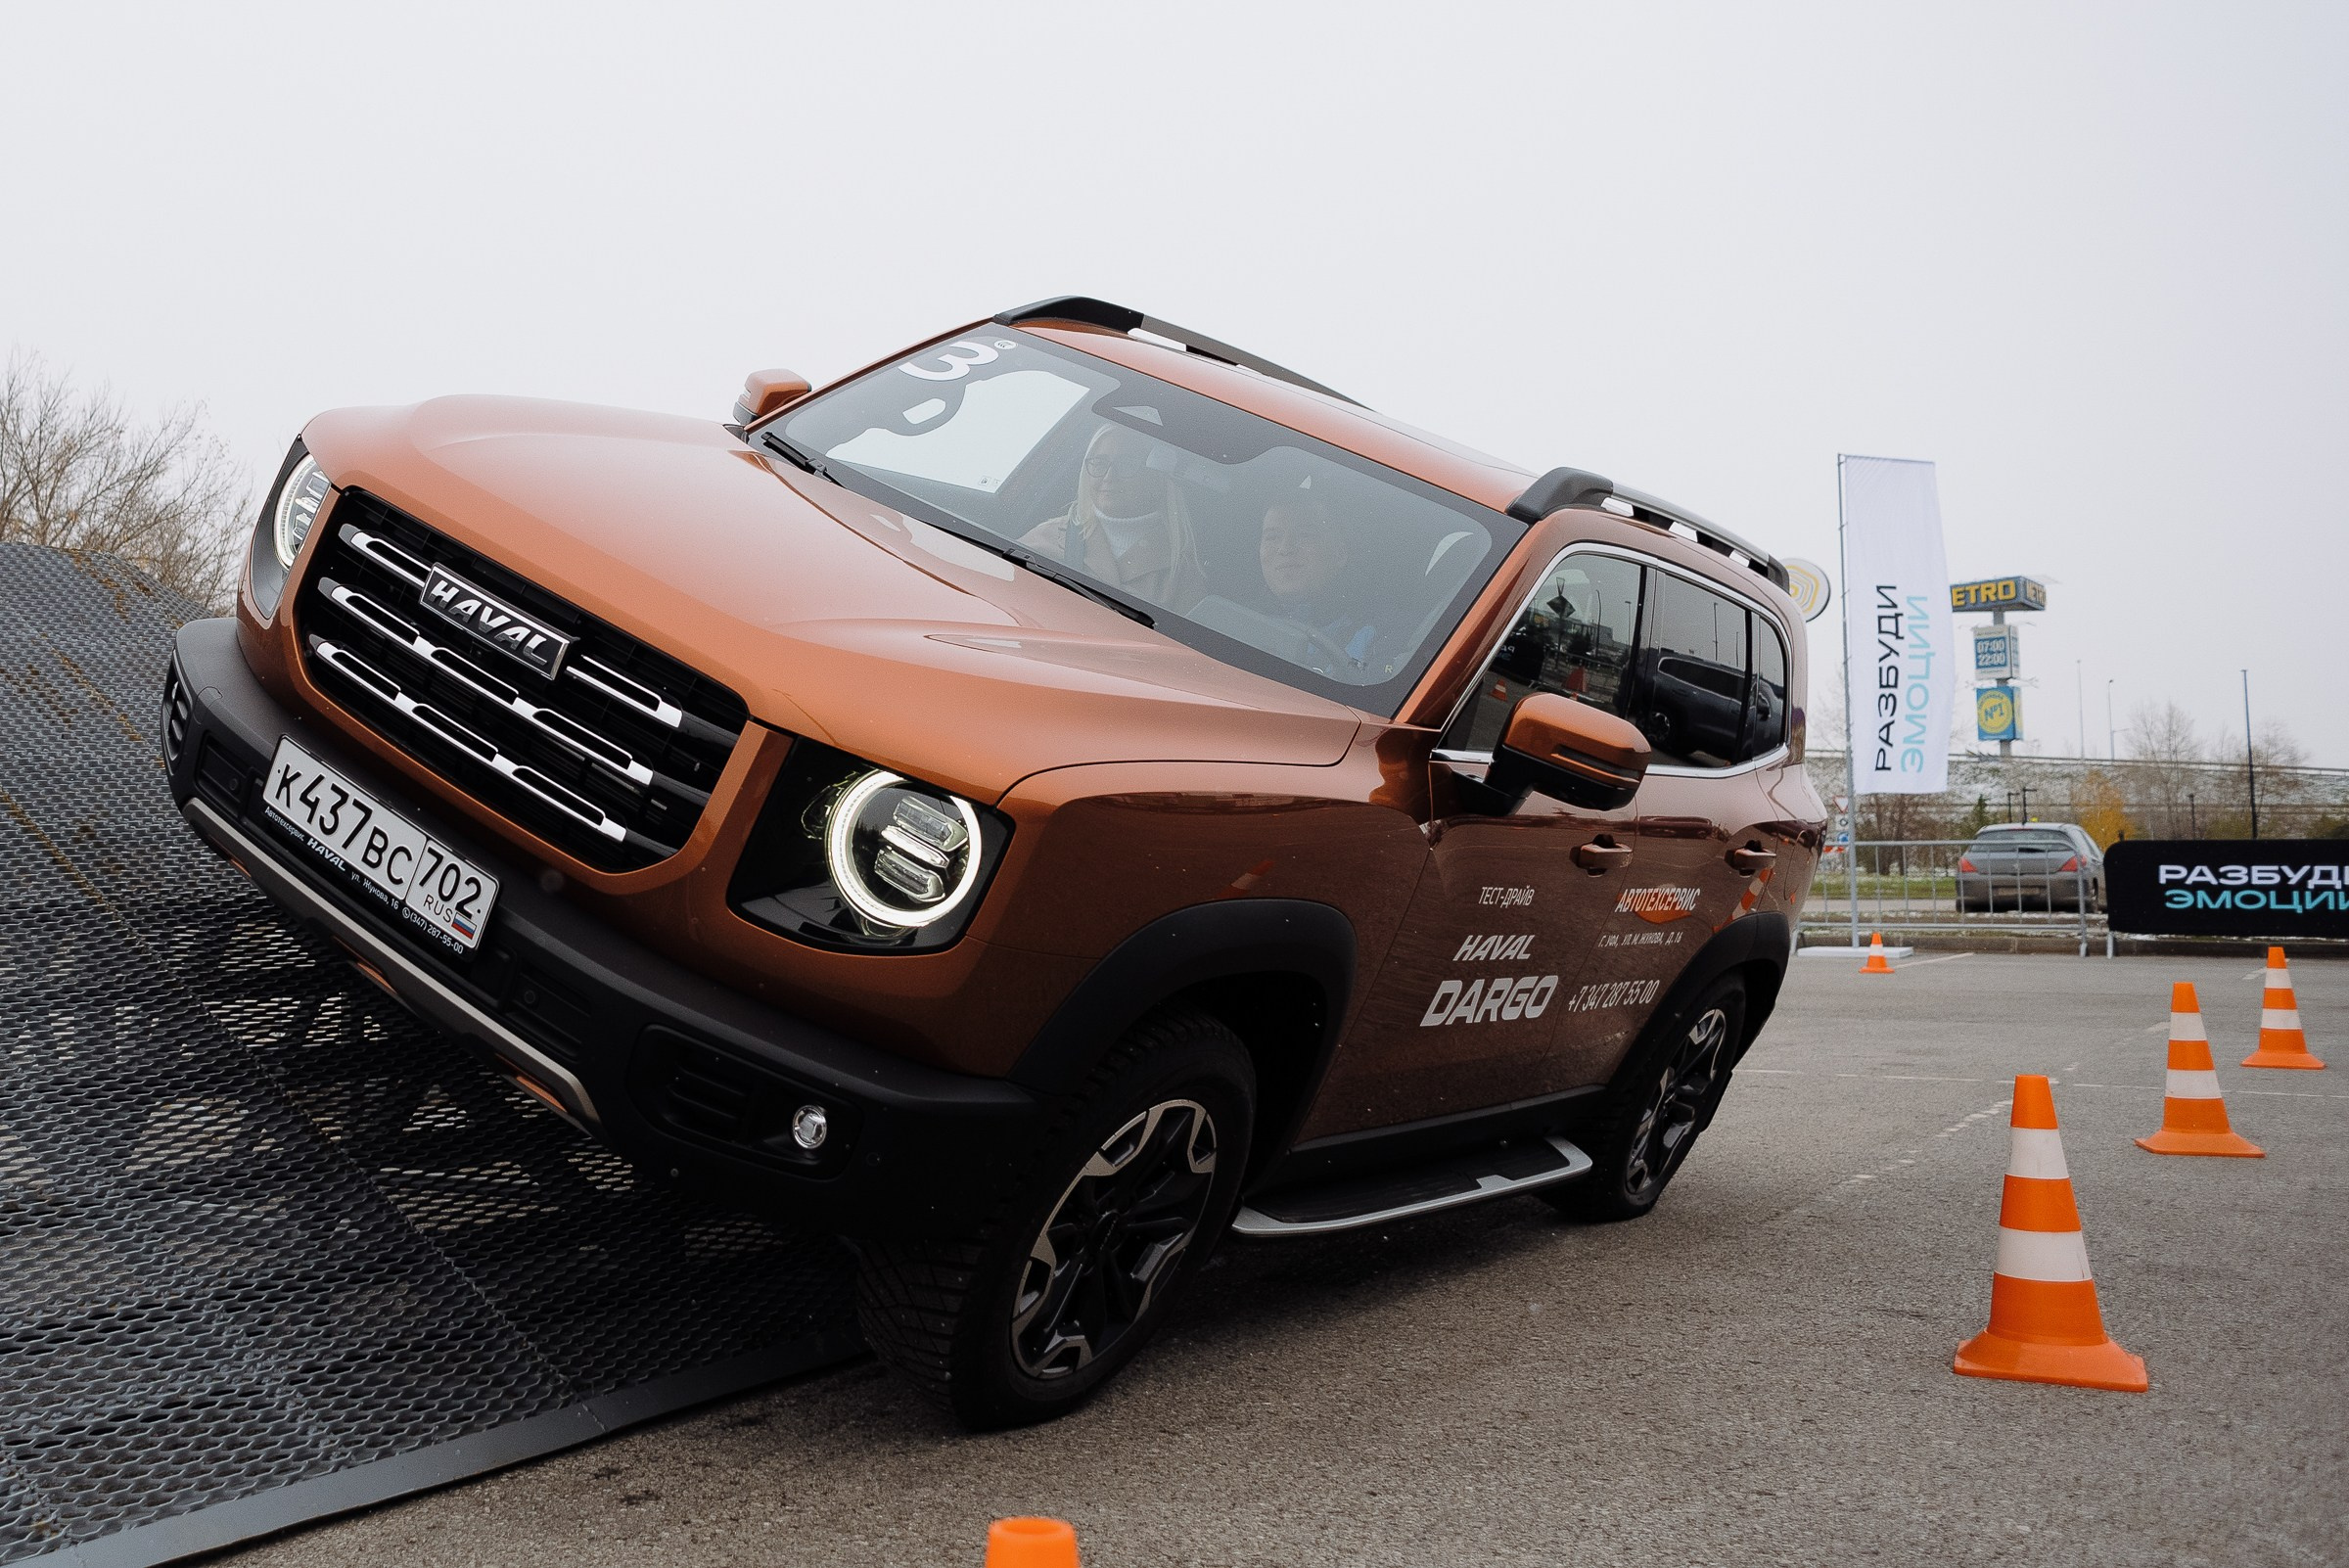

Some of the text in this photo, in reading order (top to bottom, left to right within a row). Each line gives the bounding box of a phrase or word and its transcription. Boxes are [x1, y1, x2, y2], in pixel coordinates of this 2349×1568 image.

[1952, 579, 2016, 607] ETRO
[429, 579, 548, 666] HAVAL
[1875, 584, 1905, 771] РАЗБУДИ
[1901, 595, 1936, 773] ЭМОЦИИ
[264, 807, 464, 954] Автотехсервис HAVAL ул. Жукова, 16 (347) 287-55-00
[419, 846, 482, 920] 702
[1479, 885, 1535, 908] ТЕСТ-ДРАЙВ
[2159, 865, 2349, 889] РАЗБУД
[423, 894, 454, 923] RUS
[1615, 888, 1701, 912] АВТОТЕХСЕРВИС
[1452, 935, 1536, 961] HAVAL
[1420, 975, 1559, 1027] DARGO
